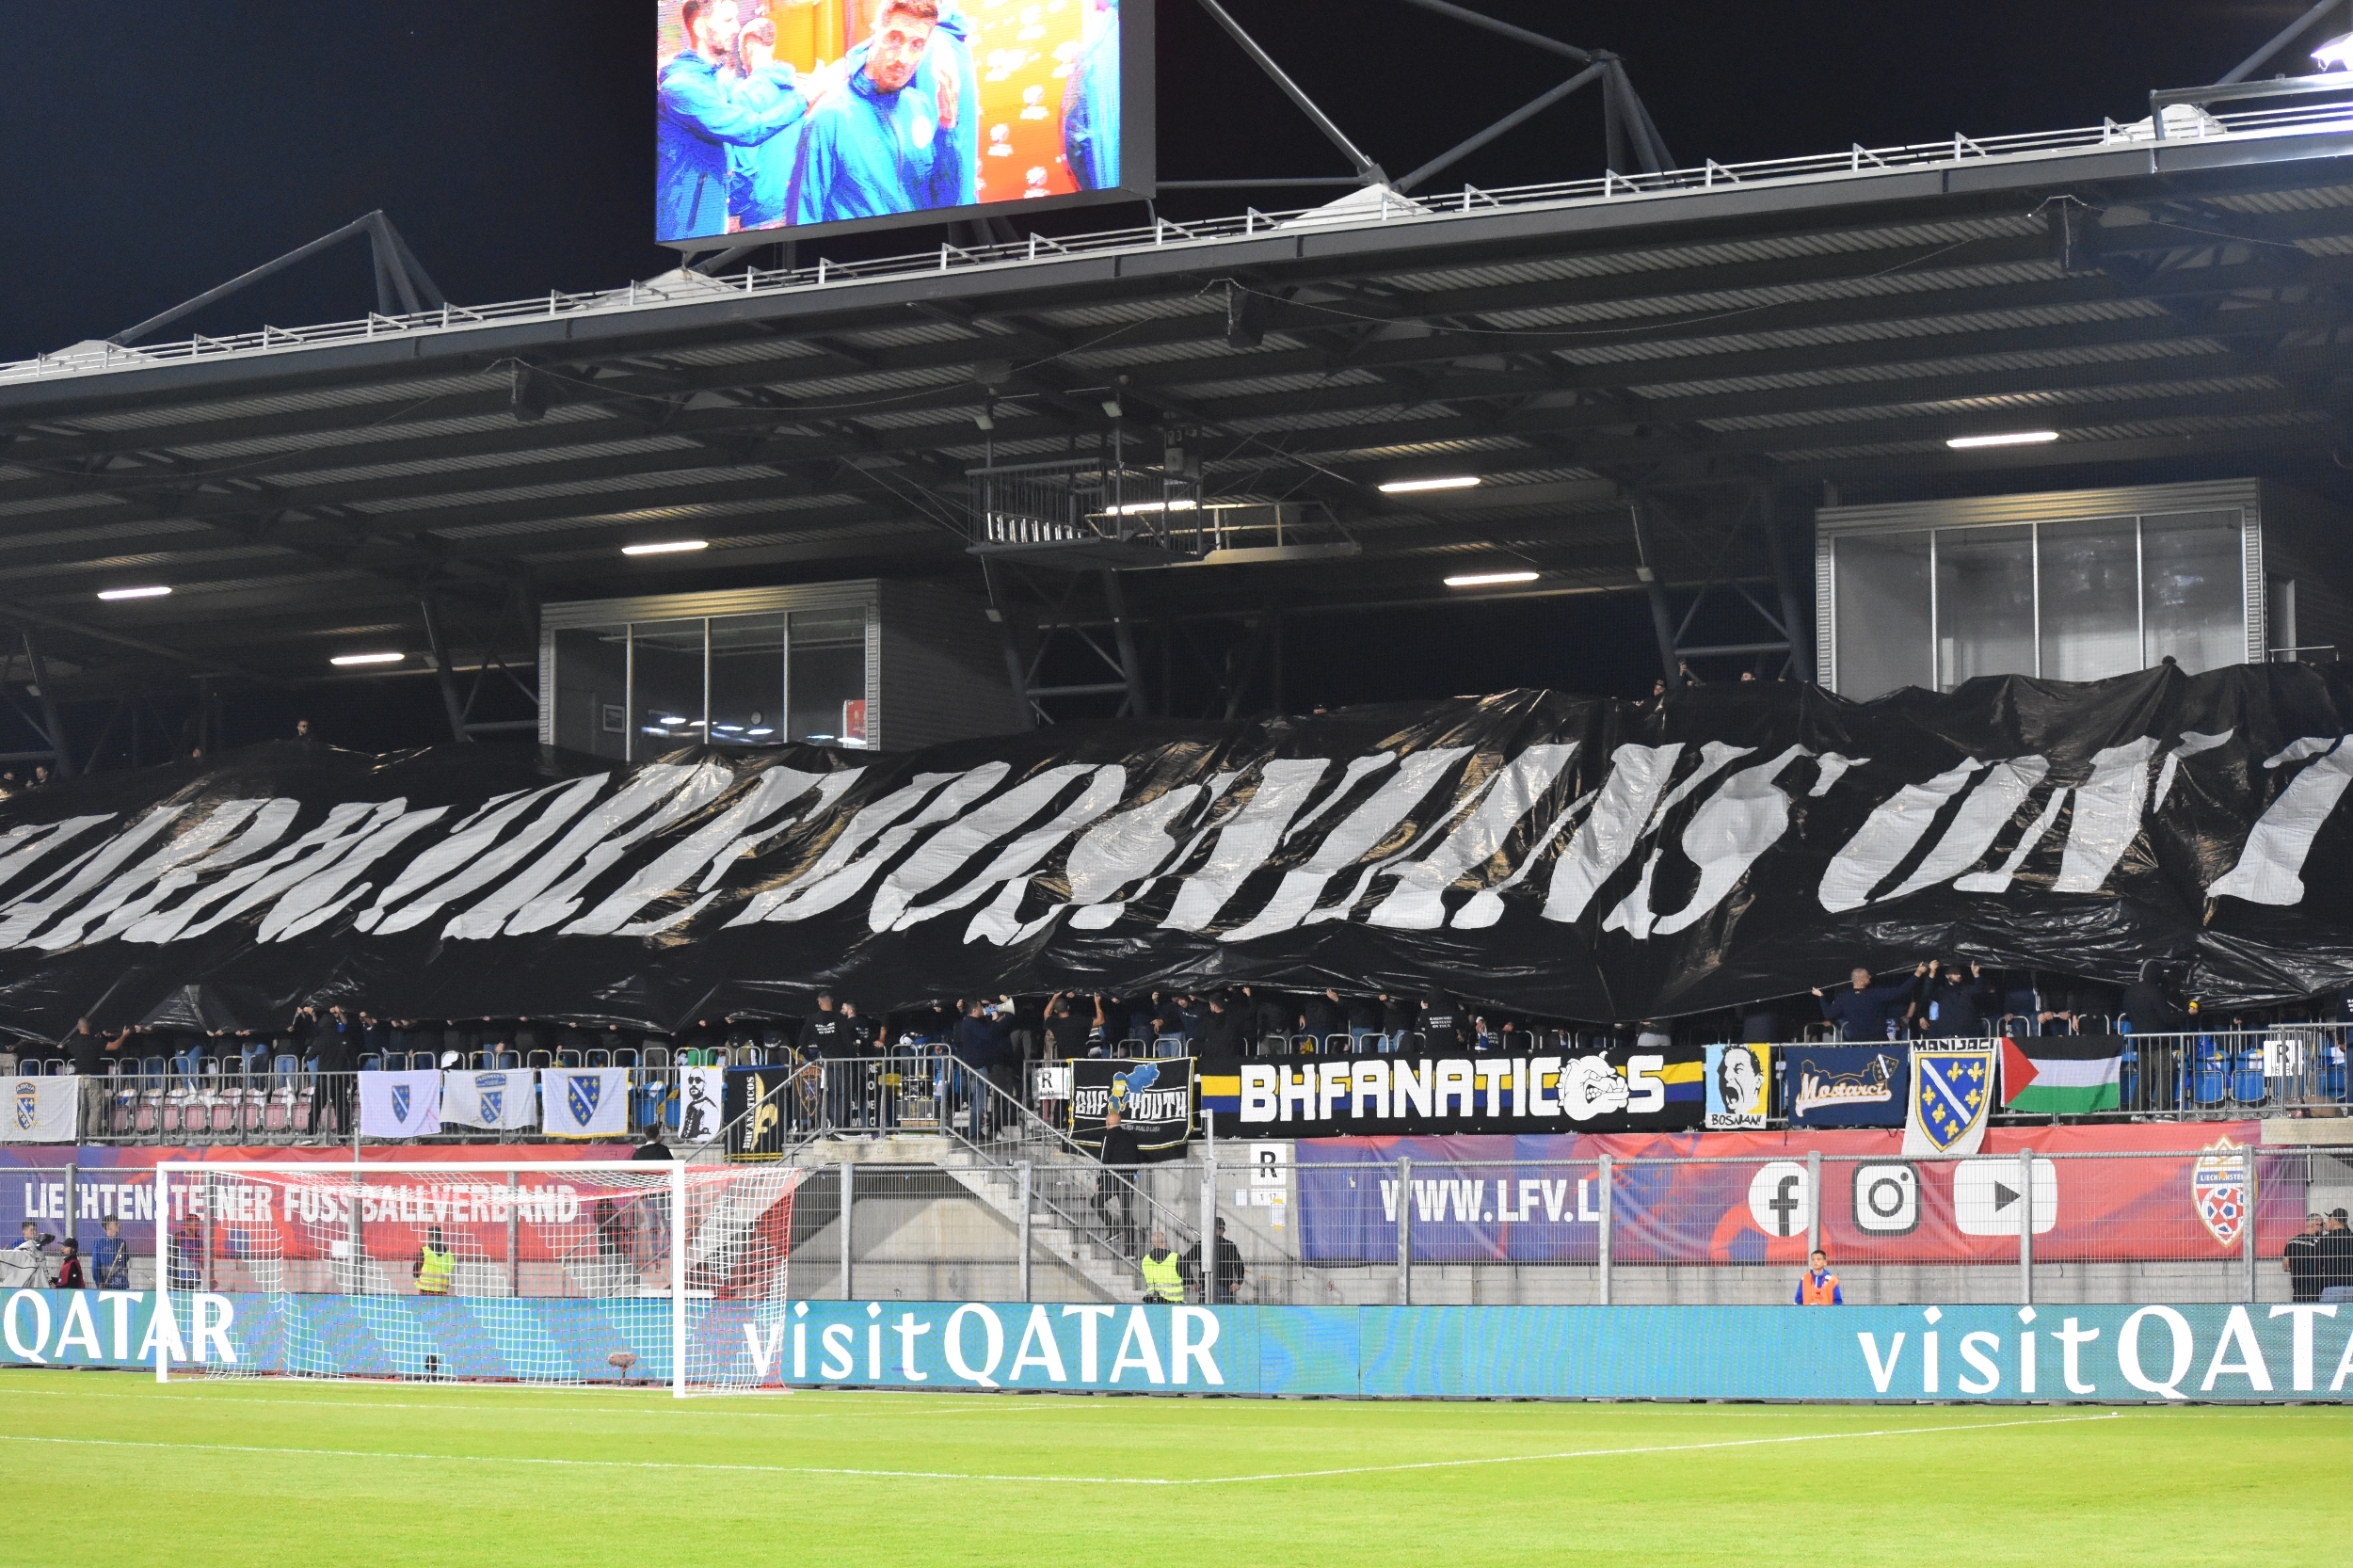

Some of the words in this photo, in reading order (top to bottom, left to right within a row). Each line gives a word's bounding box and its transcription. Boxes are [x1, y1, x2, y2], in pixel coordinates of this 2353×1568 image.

[1913, 1037, 1993, 1051] MANIJACI
[1041, 1071, 1053, 1089] R
[1796, 1072, 1885, 1106] Mostarci
[1075, 1090, 1109, 1115] BHF
[1128, 1091, 1188, 1120] YOUTH
[1259, 1150, 1278, 1178] R
[24, 1182, 274, 1223] LIEHTENTENER
[1379, 1178, 1600, 1223] WWW.LFV.L
[3, 1288, 238, 1364] QATAR
